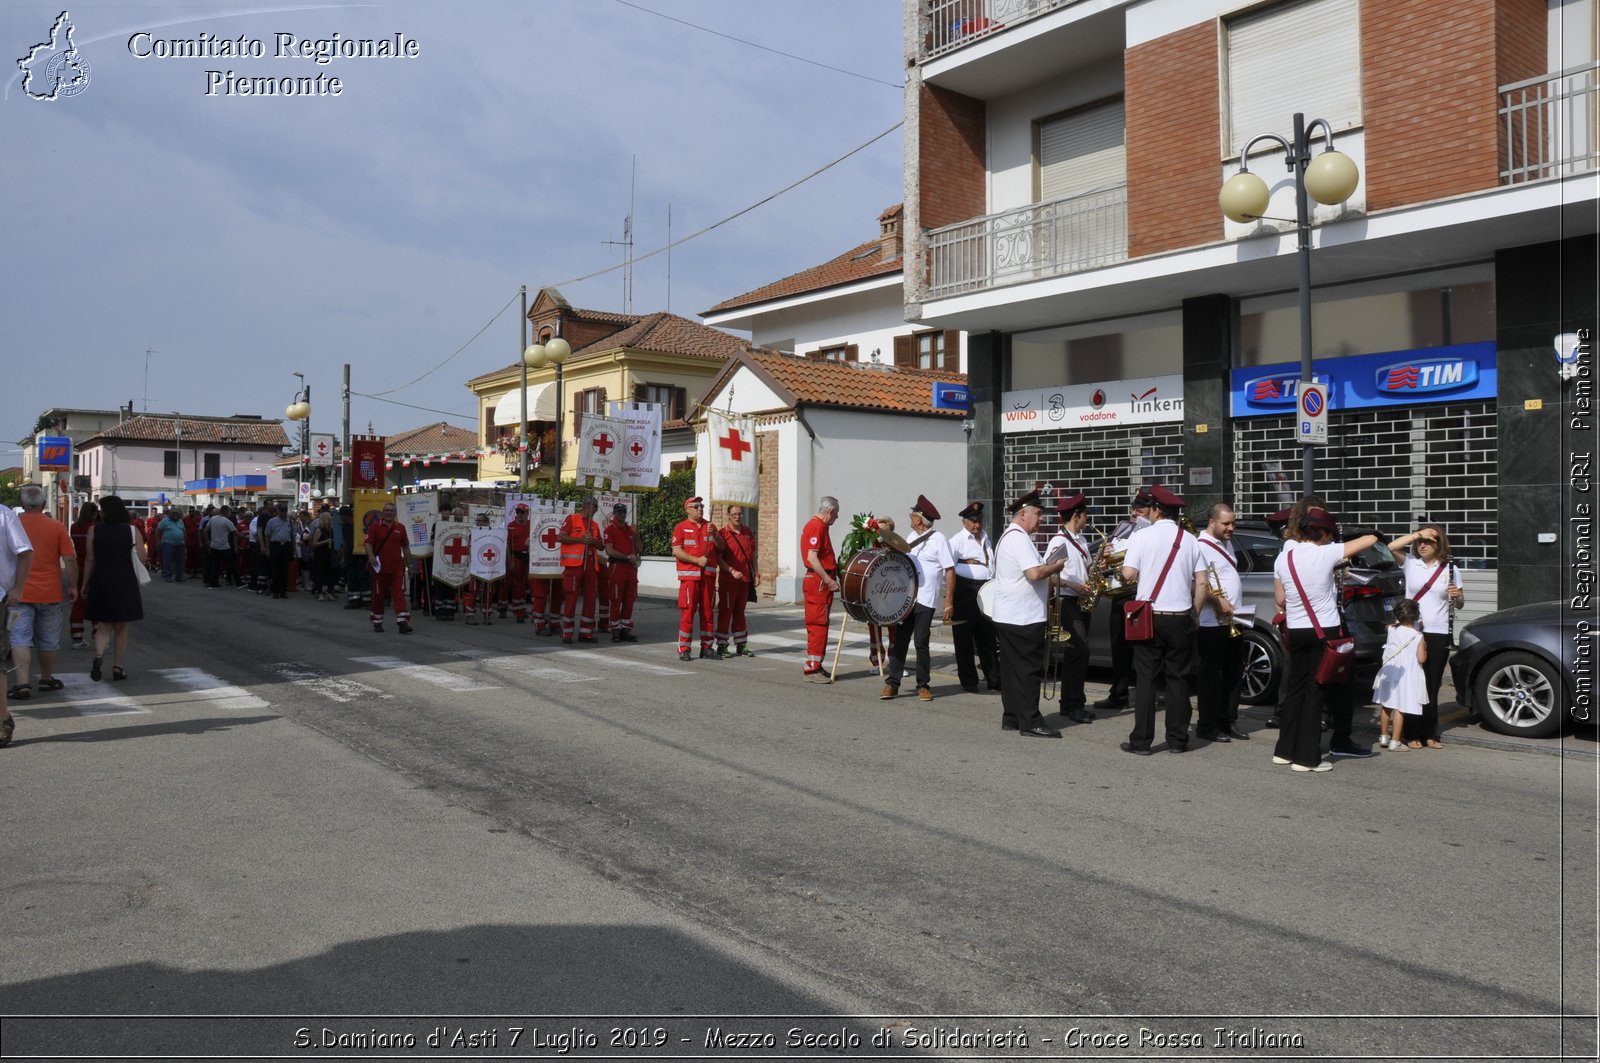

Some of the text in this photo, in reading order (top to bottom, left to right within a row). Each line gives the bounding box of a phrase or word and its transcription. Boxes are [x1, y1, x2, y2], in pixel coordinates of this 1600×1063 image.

[1420, 362, 1463, 387] TIM
[1282, 376, 1319, 397] TI
[955, 392, 967, 401] TIM
[1048, 393, 1066, 422] 3
[1006, 410, 1037, 422] WIND
[1079, 411, 1117, 422] vodafone
[43, 446, 67, 460] IP
